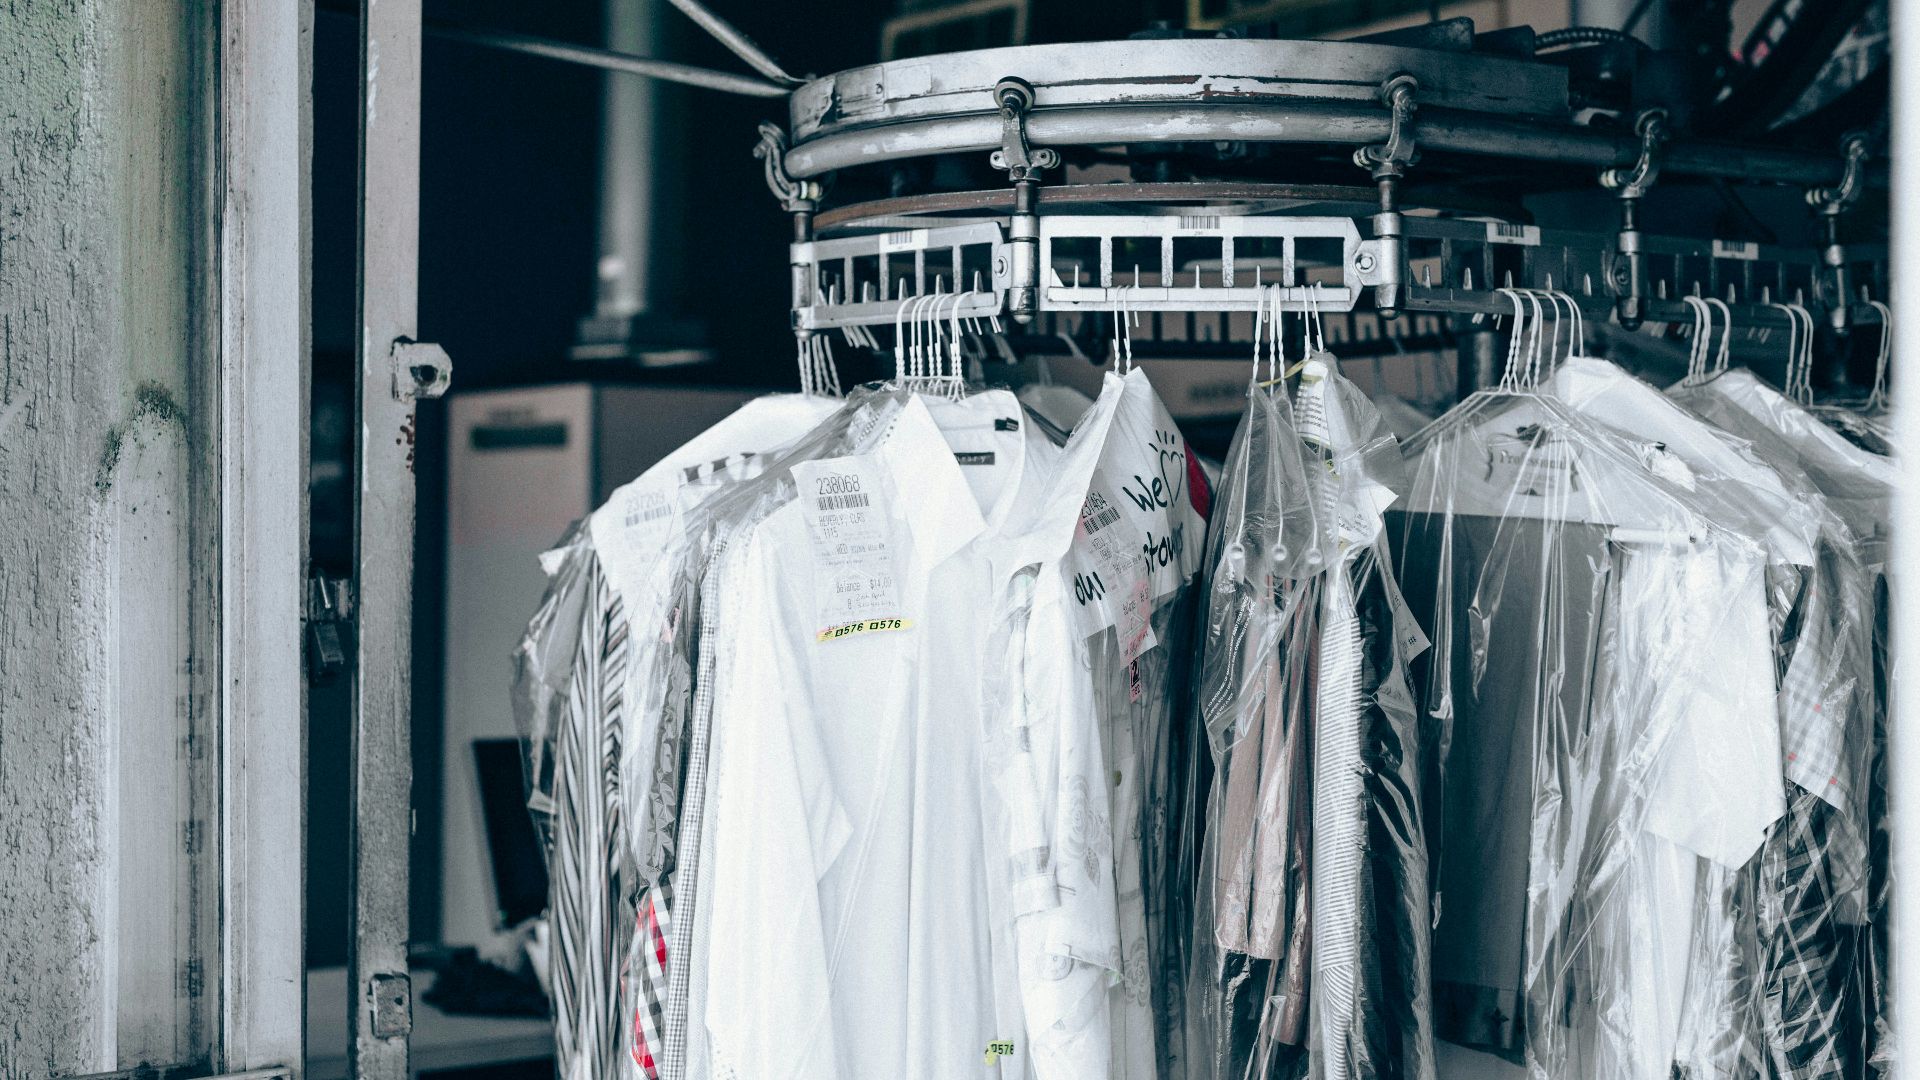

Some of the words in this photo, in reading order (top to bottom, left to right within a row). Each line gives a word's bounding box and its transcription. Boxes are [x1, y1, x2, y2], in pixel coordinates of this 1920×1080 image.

[816, 474, 860, 495] 238068
[1122, 475, 1168, 512] We
[843, 623, 864, 634] 576
[879, 619, 901, 629] 576
[998, 1043, 1015, 1055] 576
